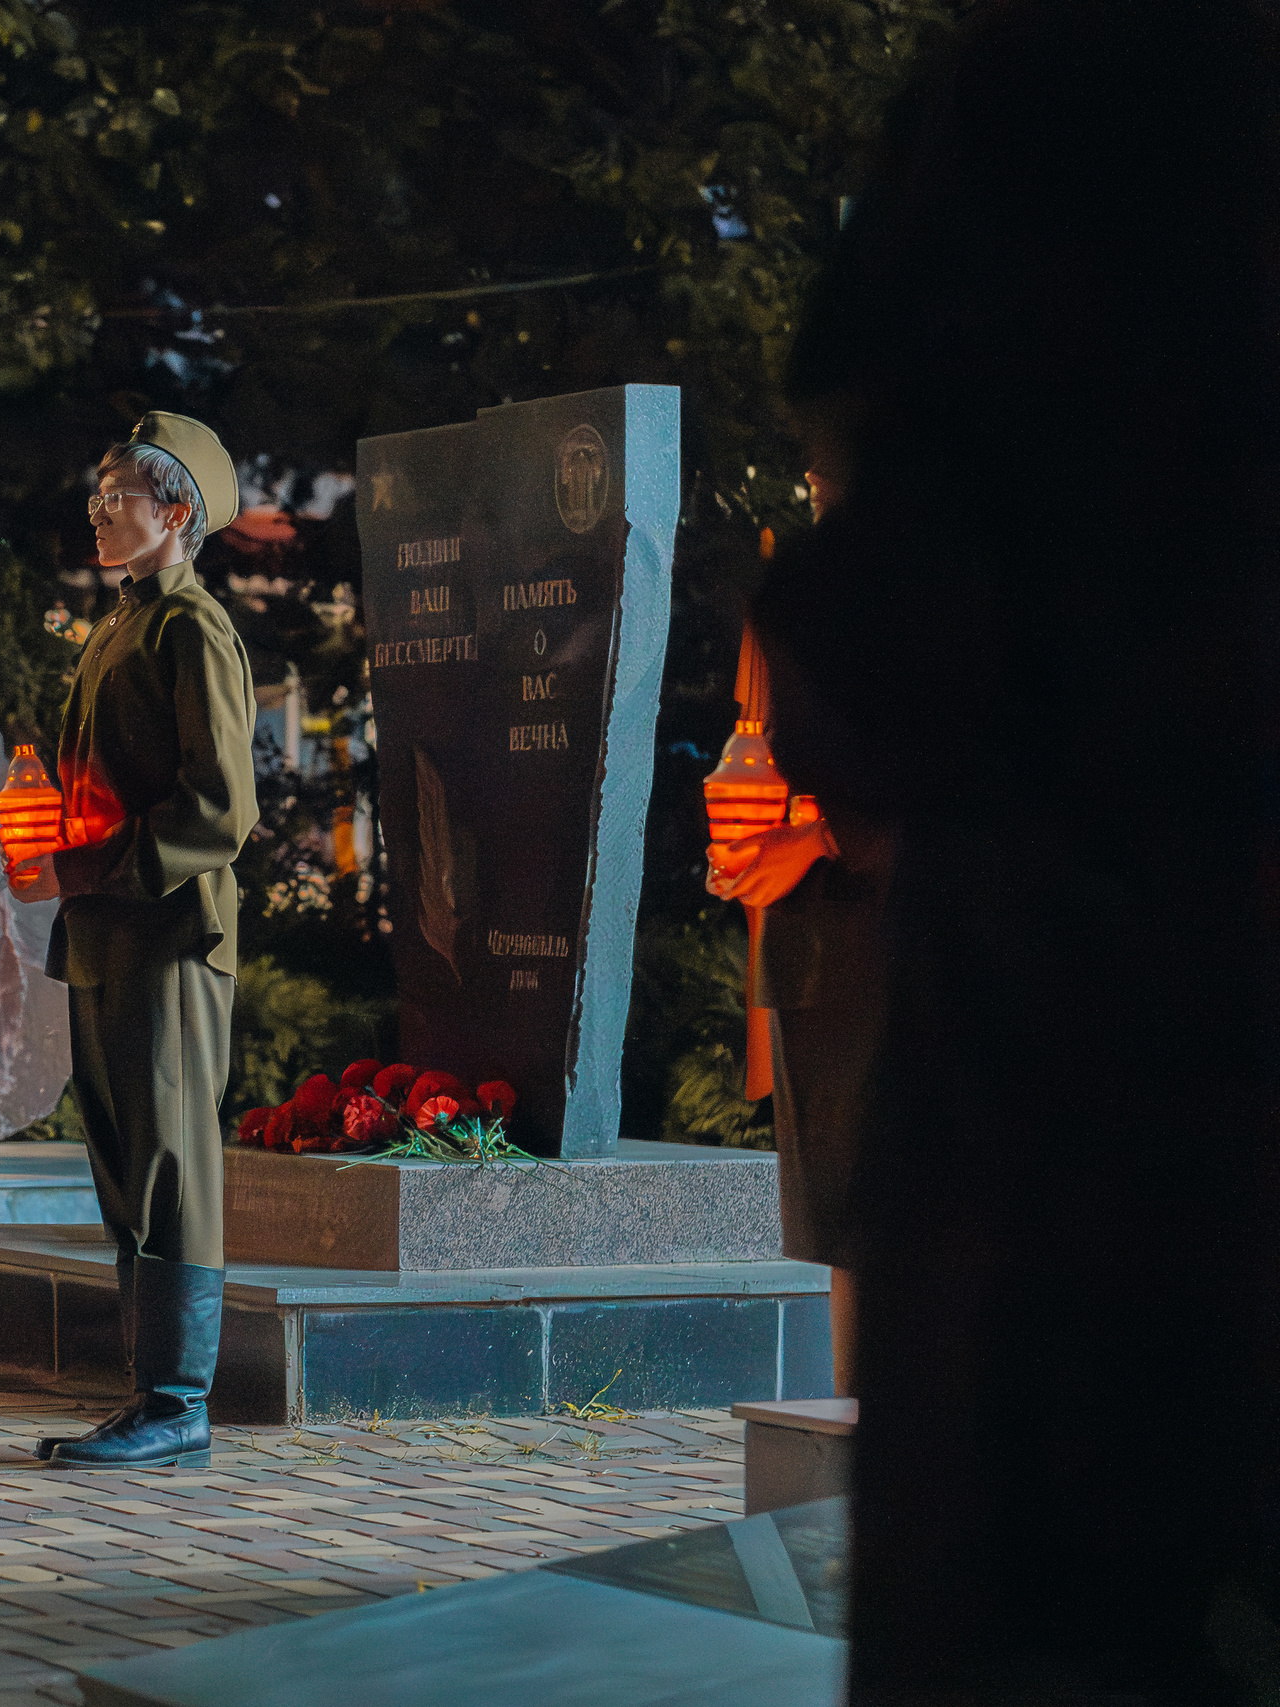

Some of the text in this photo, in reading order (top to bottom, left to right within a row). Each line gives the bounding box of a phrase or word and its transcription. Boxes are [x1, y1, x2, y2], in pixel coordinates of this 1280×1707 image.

[503, 578, 577, 611] ПАМЯТЬ
[533, 628, 547, 656] О
[522, 673, 557, 701] ВАС
[509, 721, 569, 751] ВЕЧНА
